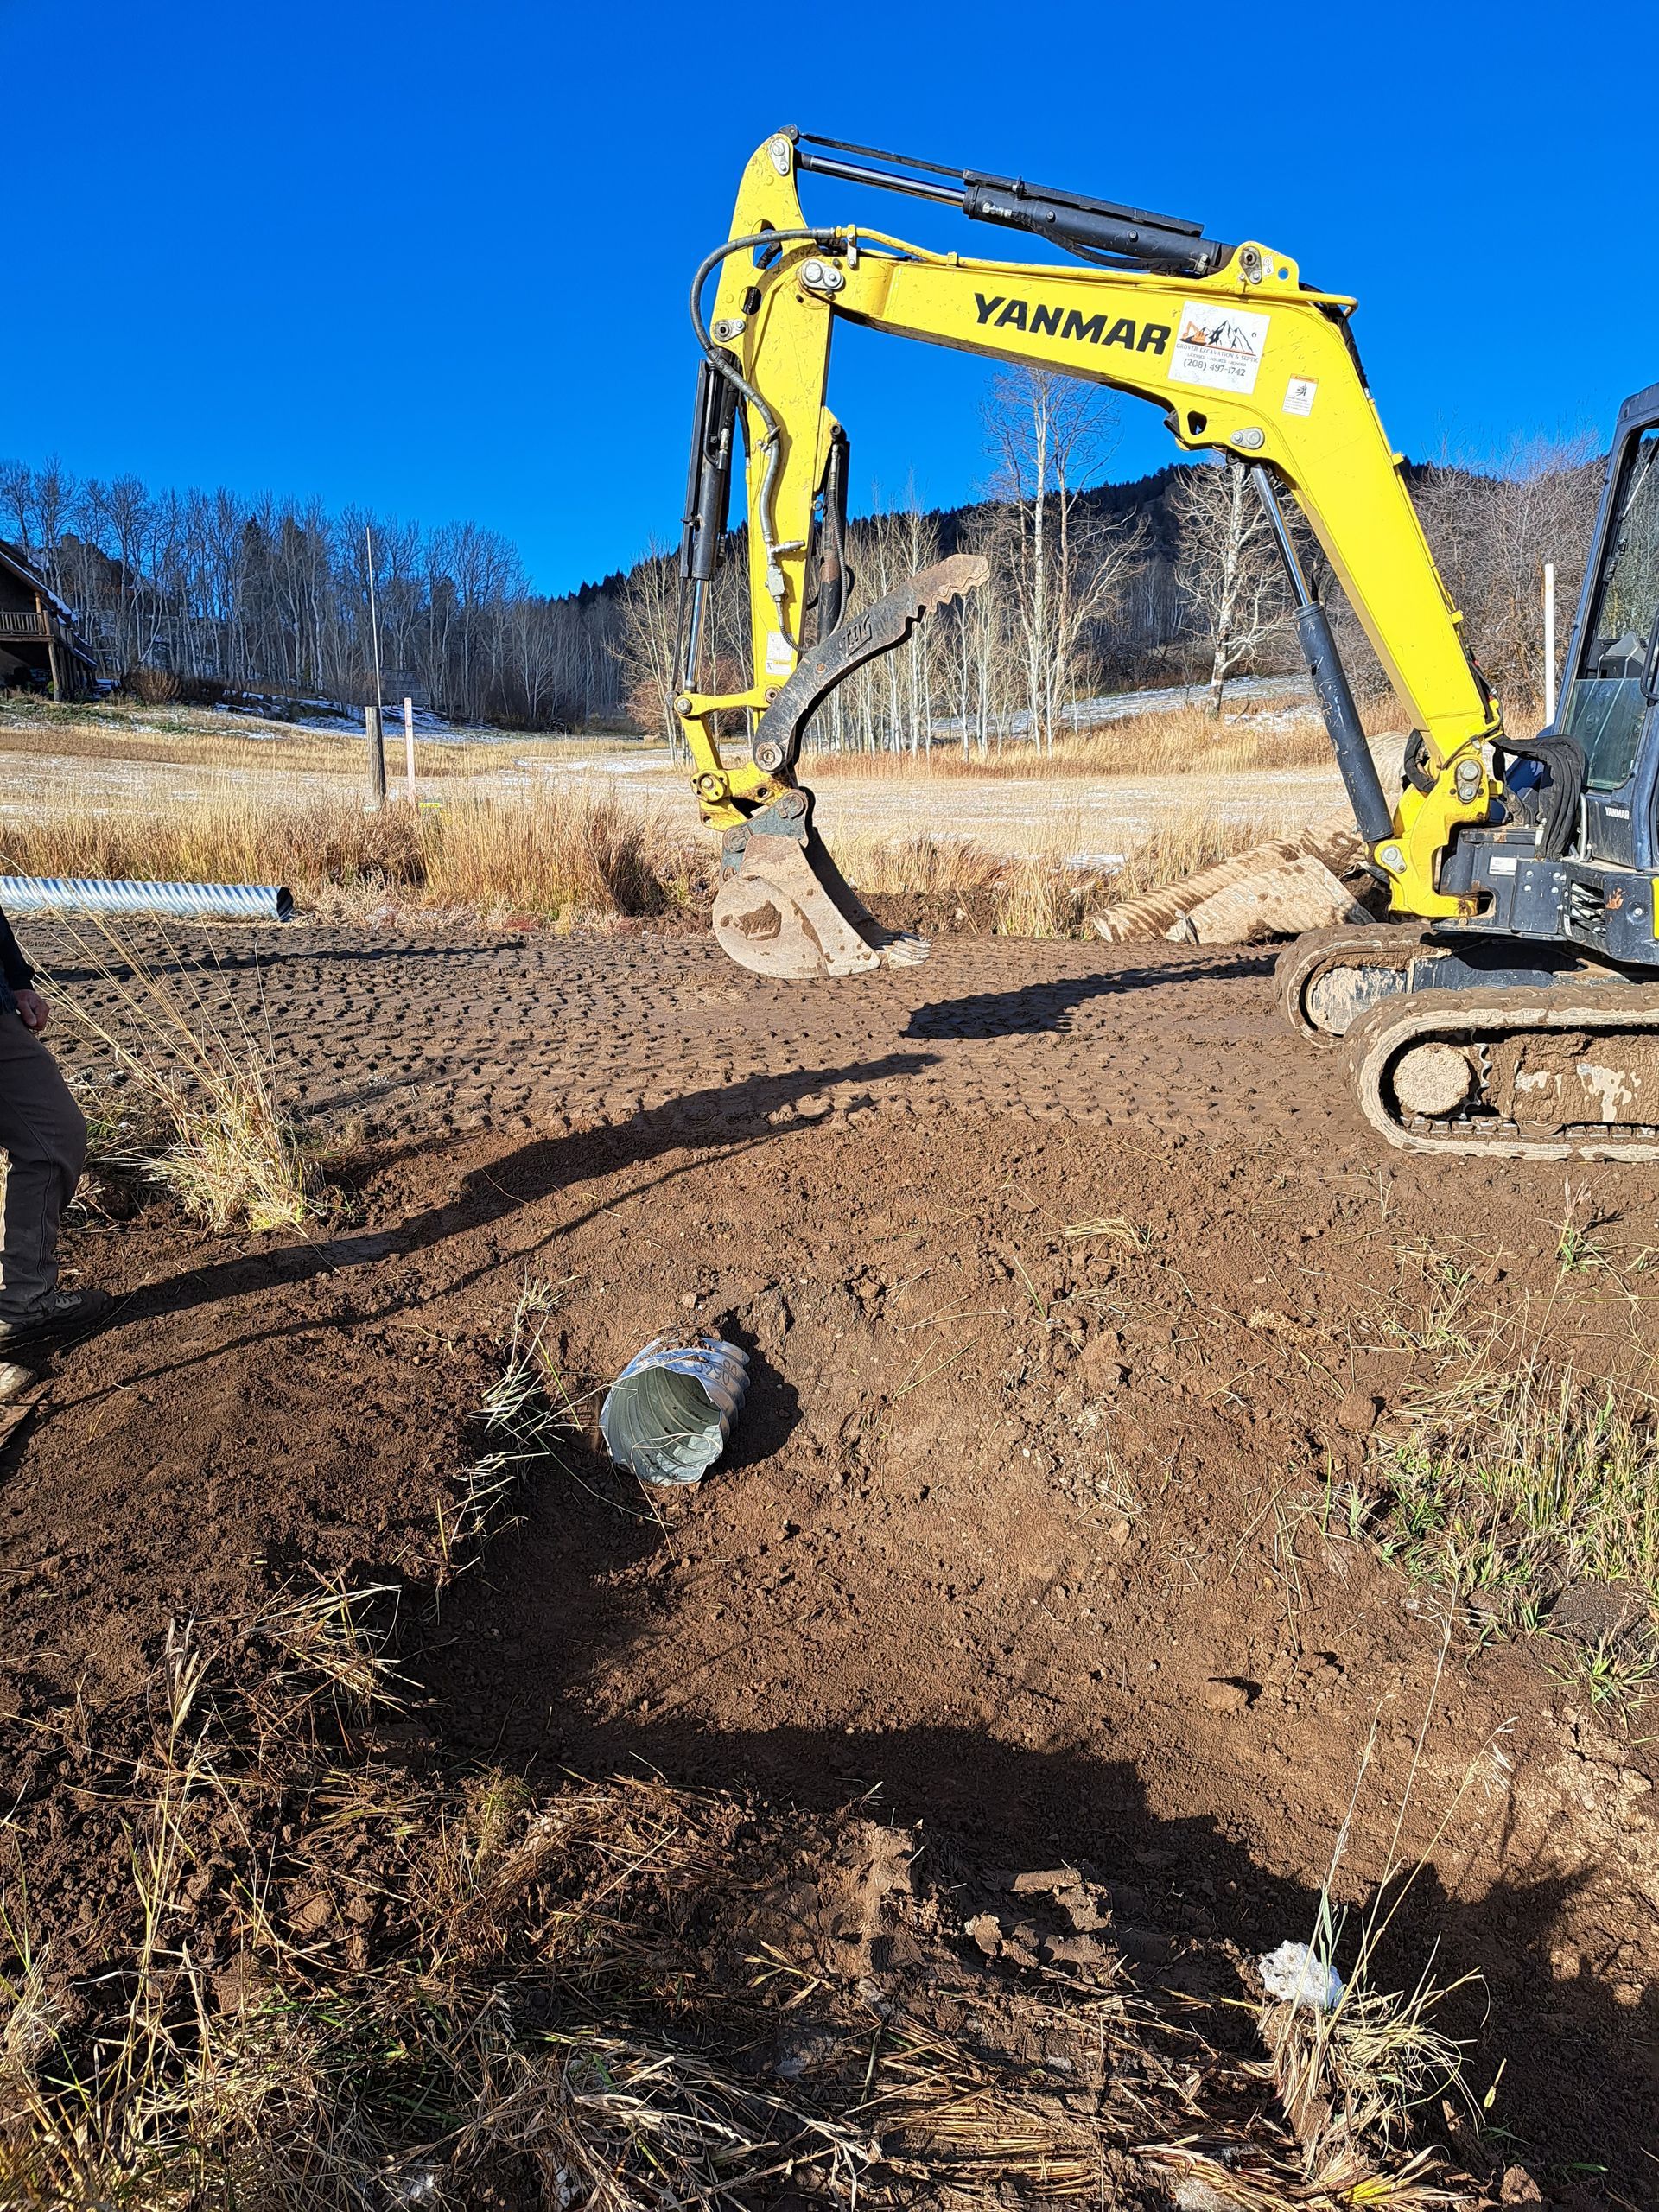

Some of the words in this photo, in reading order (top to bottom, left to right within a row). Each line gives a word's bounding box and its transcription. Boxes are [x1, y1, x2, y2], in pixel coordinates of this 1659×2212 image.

[974, 292, 1172, 356] YANMAR
[1176, 343, 1198, 352] GROVER
[1199, 348, 1235, 359] EXCAVATION
[1240, 354, 1260, 364] SEPTIC
[1183, 358, 1207, 371] (208)
[1209, 364, 1246, 376] 497-1742
[1605, 806, 1630, 820] YANMAR
